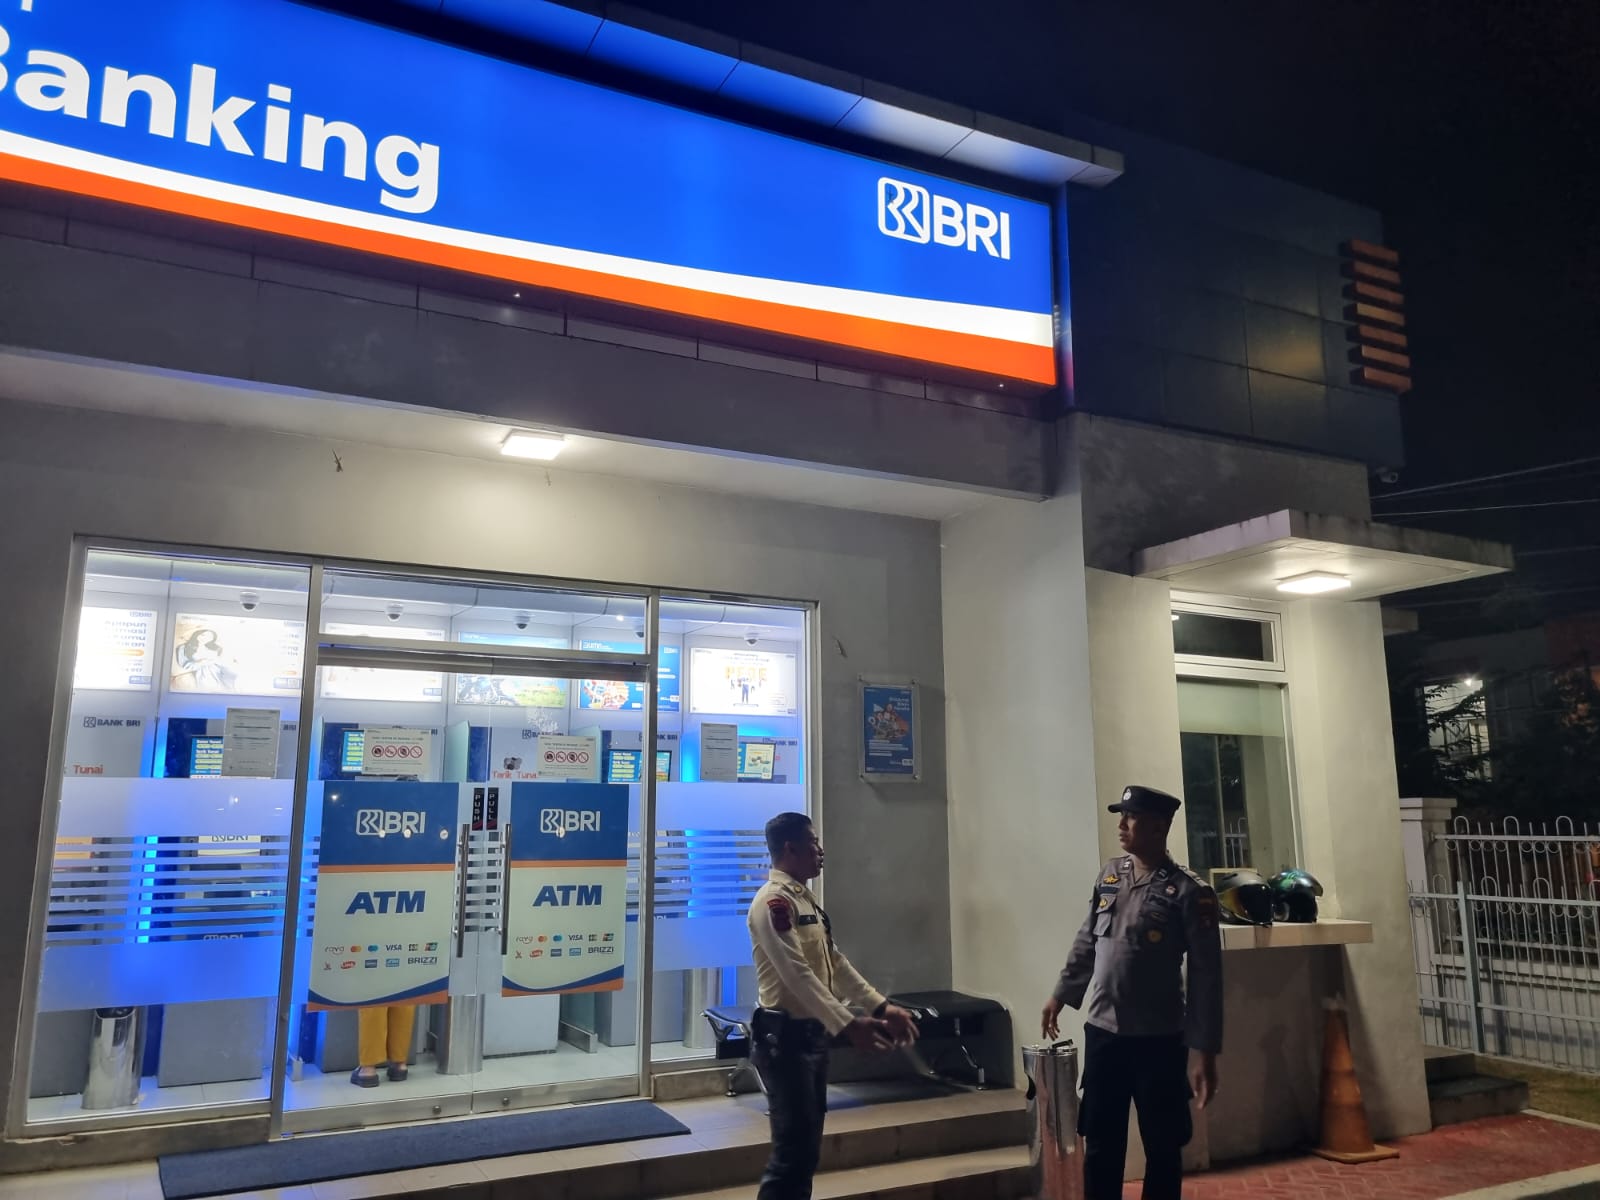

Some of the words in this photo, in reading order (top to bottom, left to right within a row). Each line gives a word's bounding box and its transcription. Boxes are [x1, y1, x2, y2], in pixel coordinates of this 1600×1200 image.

[0, 24, 440, 214] anking
[933, 194, 1011, 260] BRI
[97, 718, 123, 727] BANK
[126, 719, 141, 727] BRI
[73, 764, 104, 774] Tunai
[517, 771, 538, 779] Tuna
[385, 811, 426, 834] BRI
[565, 810, 601, 832] BRI
[345, 891, 426, 914] ATM
[532, 885, 602, 907] ATM
